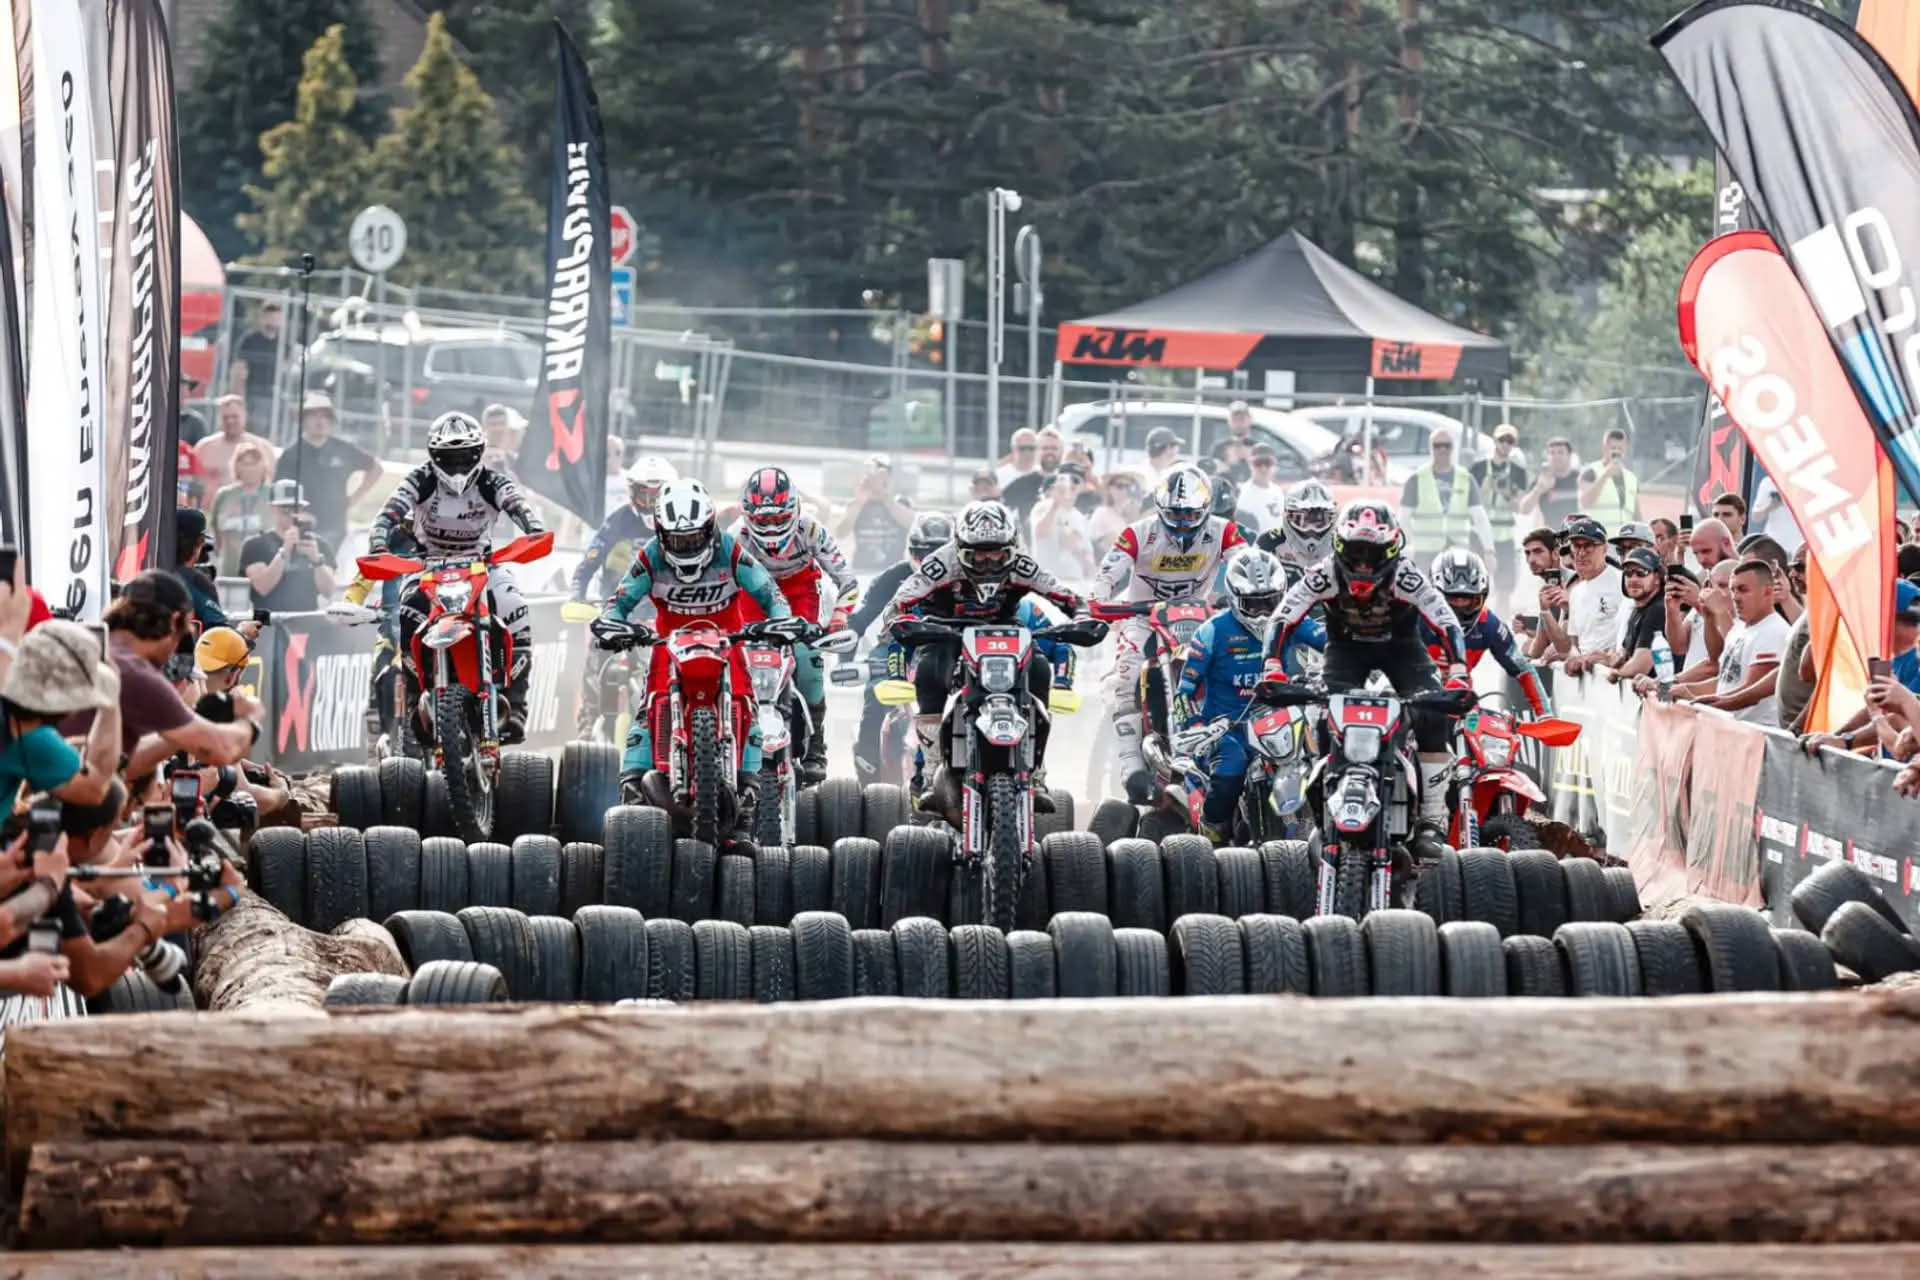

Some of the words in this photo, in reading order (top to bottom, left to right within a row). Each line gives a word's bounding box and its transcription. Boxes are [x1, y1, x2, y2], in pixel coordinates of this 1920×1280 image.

[1072, 327, 1167, 361] KTM
[1381, 341, 1422, 373] KTM
[667, 583, 728, 604] LEATT
[987, 641, 1008, 650] 36
[1356, 711, 1374, 721] 11
